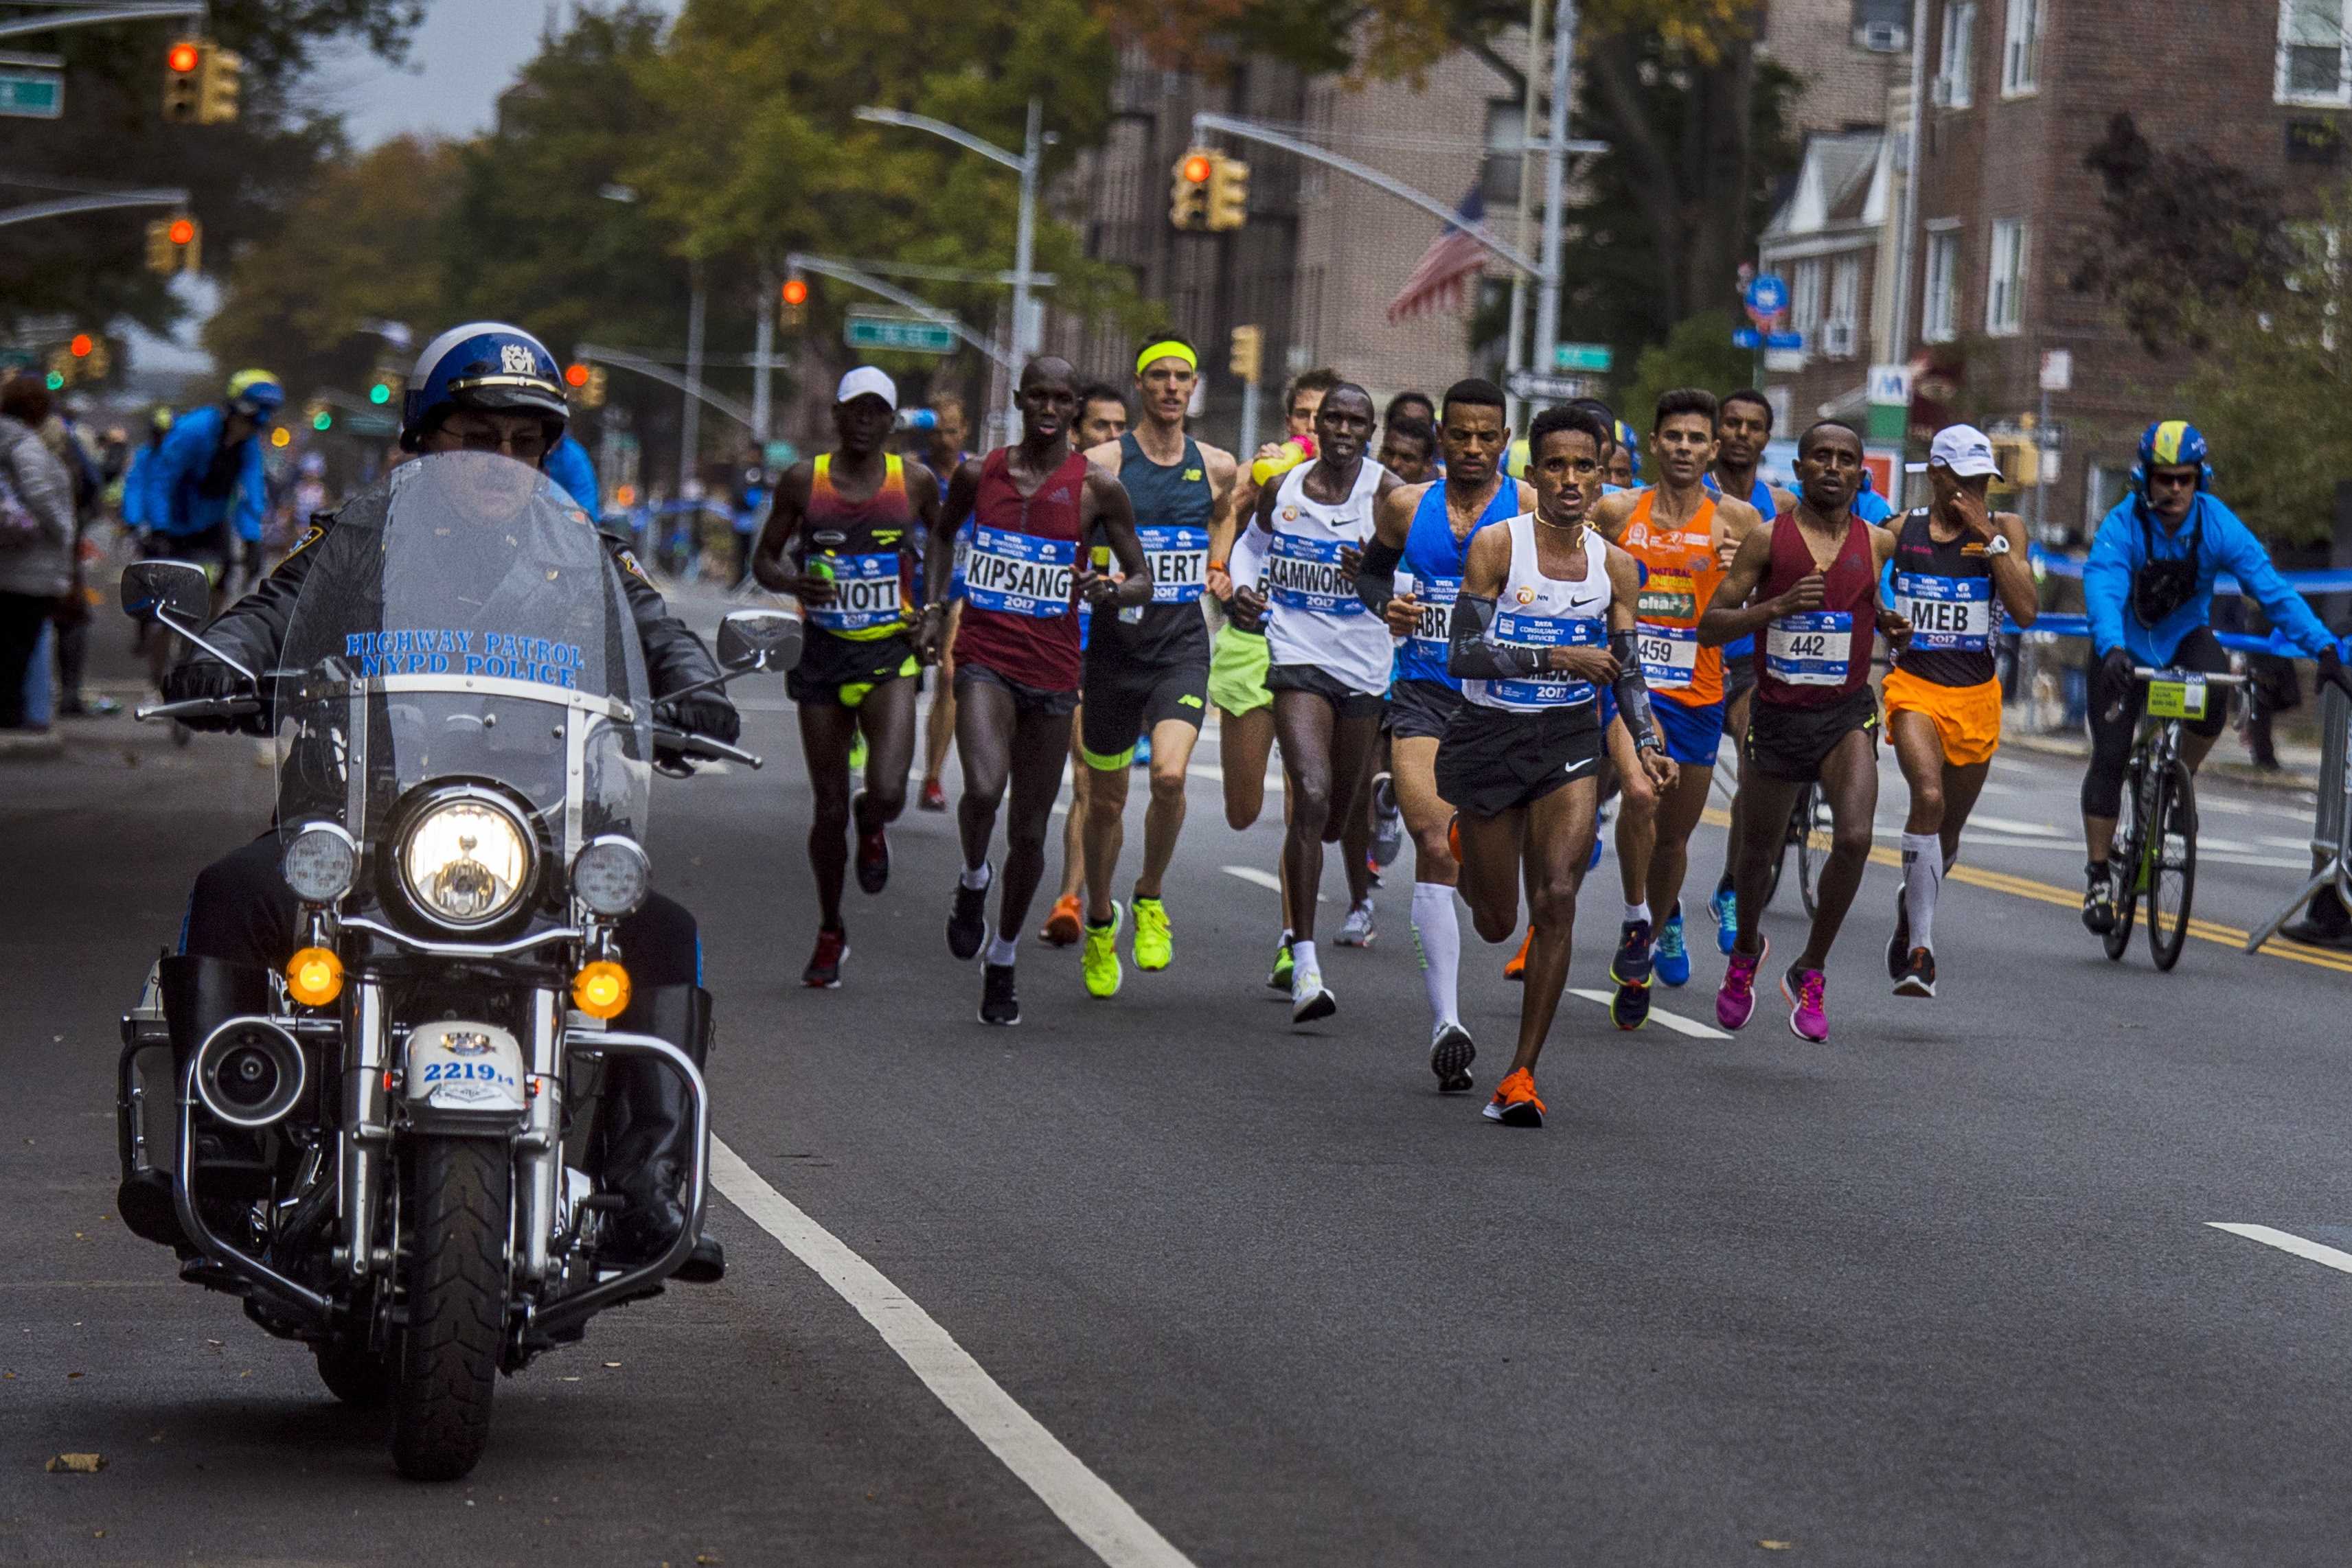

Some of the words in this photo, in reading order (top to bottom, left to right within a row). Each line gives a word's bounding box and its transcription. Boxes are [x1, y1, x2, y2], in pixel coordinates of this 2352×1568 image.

[968, 554, 1072, 598] KIPSANG
[1003, 596, 1036, 609] 2017
[1305, 596, 1336, 608] 2017
[1414, 604, 1449, 638] ABR
[1912, 601, 1968, 632] MEB
[1519, 626, 1564, 636] CONSULTANCY
[1527, 634, 1556, 643] SERVICES
[1928, 634, 1956, 644] 2017
[346, 630, 474, 657] HIGHWAY
[484, 632, 585, 670] PATROL
[1639, 639, 1672, 662] 459
[1790, 636, 1825, 656] 442
[361, 653, 450, 677] NYPD
[464, 656, 576, 689] POLICE
[1535, 687, 1567, 699] 2017
[424, 1063, 495, 1083] 2219
